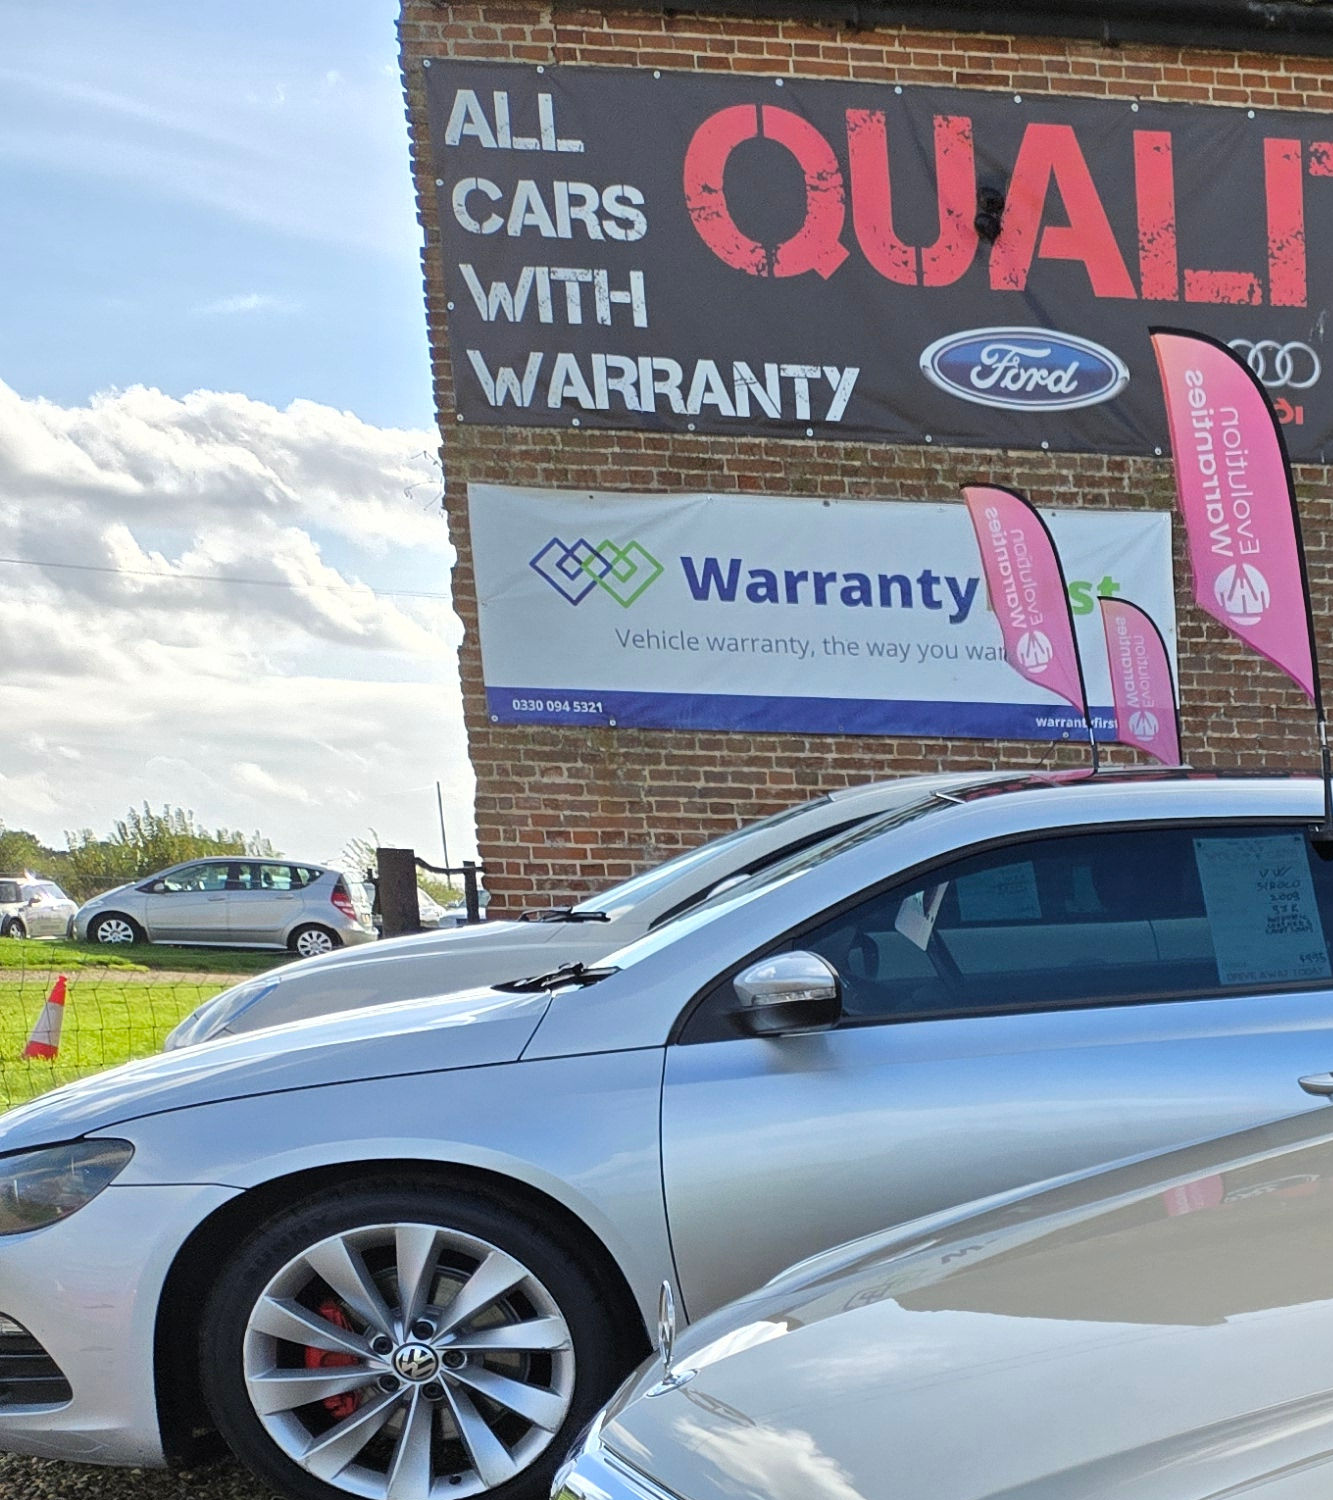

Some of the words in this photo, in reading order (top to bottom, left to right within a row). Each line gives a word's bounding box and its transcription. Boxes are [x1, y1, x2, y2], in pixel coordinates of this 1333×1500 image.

[444, 89, 584, 152] ALL
[452, 177, 648, 242] CARS
[459, 264, 648, 328] WITH
[467, 350, 859, 422] WARRANTY
[971, 342, 1079, 395] Ford
[681, 555, 981, 624] Warranty
[615, 628, 699, 652] Vehicle
[706, 631, 815, 659] warranty,
[823, 634, 858, 658] the
[865, 639, 910, 666] way
[915, 640, 958, 665] you
[513, 700, 543, 711] 0330
[547, 701, 570, 712] 094
[574, 702, 603, 713] 5321
